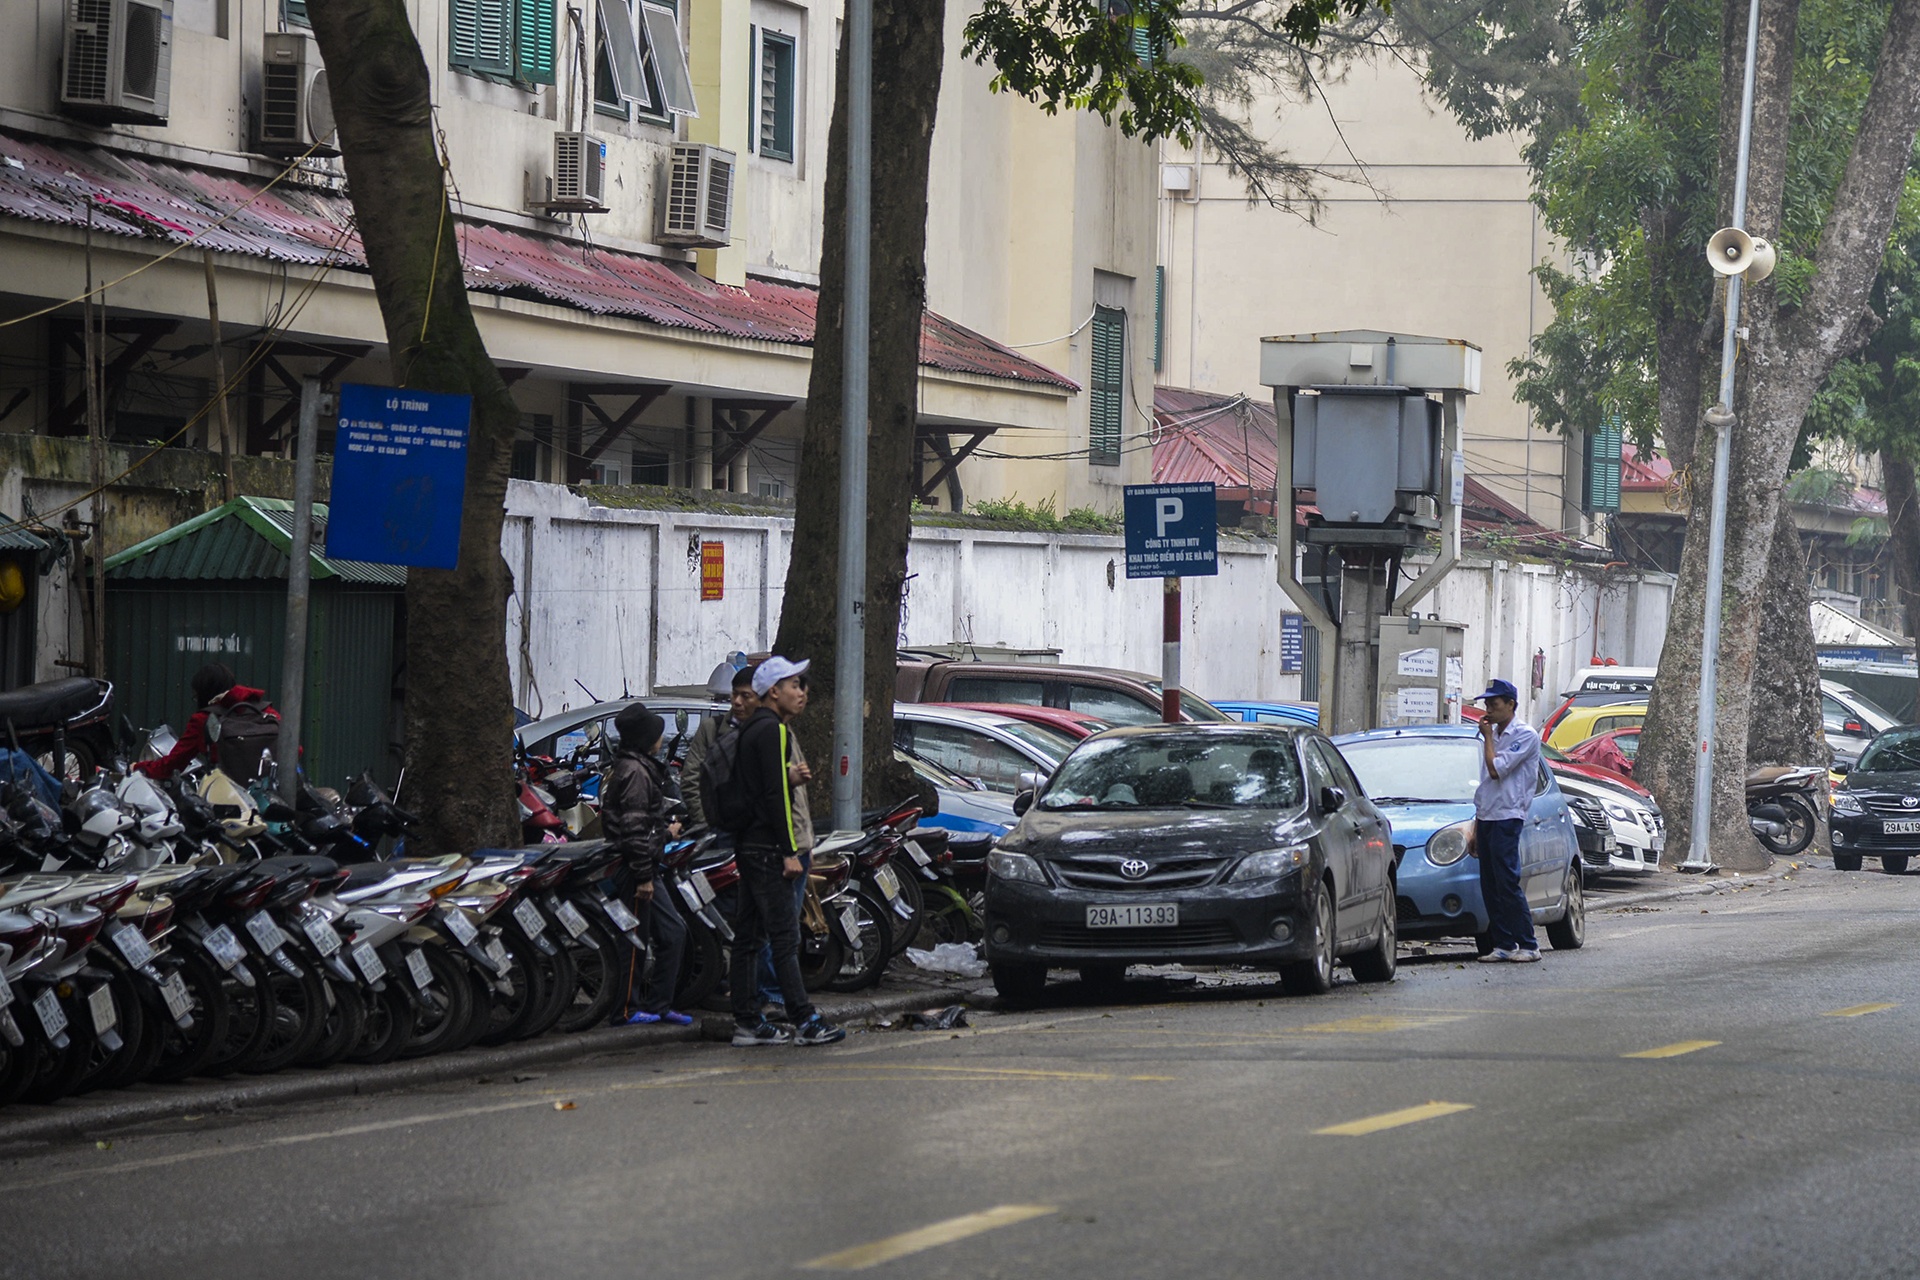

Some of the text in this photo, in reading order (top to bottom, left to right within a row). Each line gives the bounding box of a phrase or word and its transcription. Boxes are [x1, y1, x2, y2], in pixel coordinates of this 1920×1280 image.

[386, 398, 429, 412] LỘ TRÌNH
[1156, 497, 1184, 537] P
[1145, 538, 1199, 548] CÔNG TY TNHH MTV
[1129, 554, 1143, 563] KHAI
[1144, 552, 1159, 562] THÁC
[1186, 552, 1193, 561] XE
[1194, 550, 1202, 560] HÀ
[1203, 550, 1214, 561] NỘI
[1090, 907, 1175, 925] 29A-113.93
